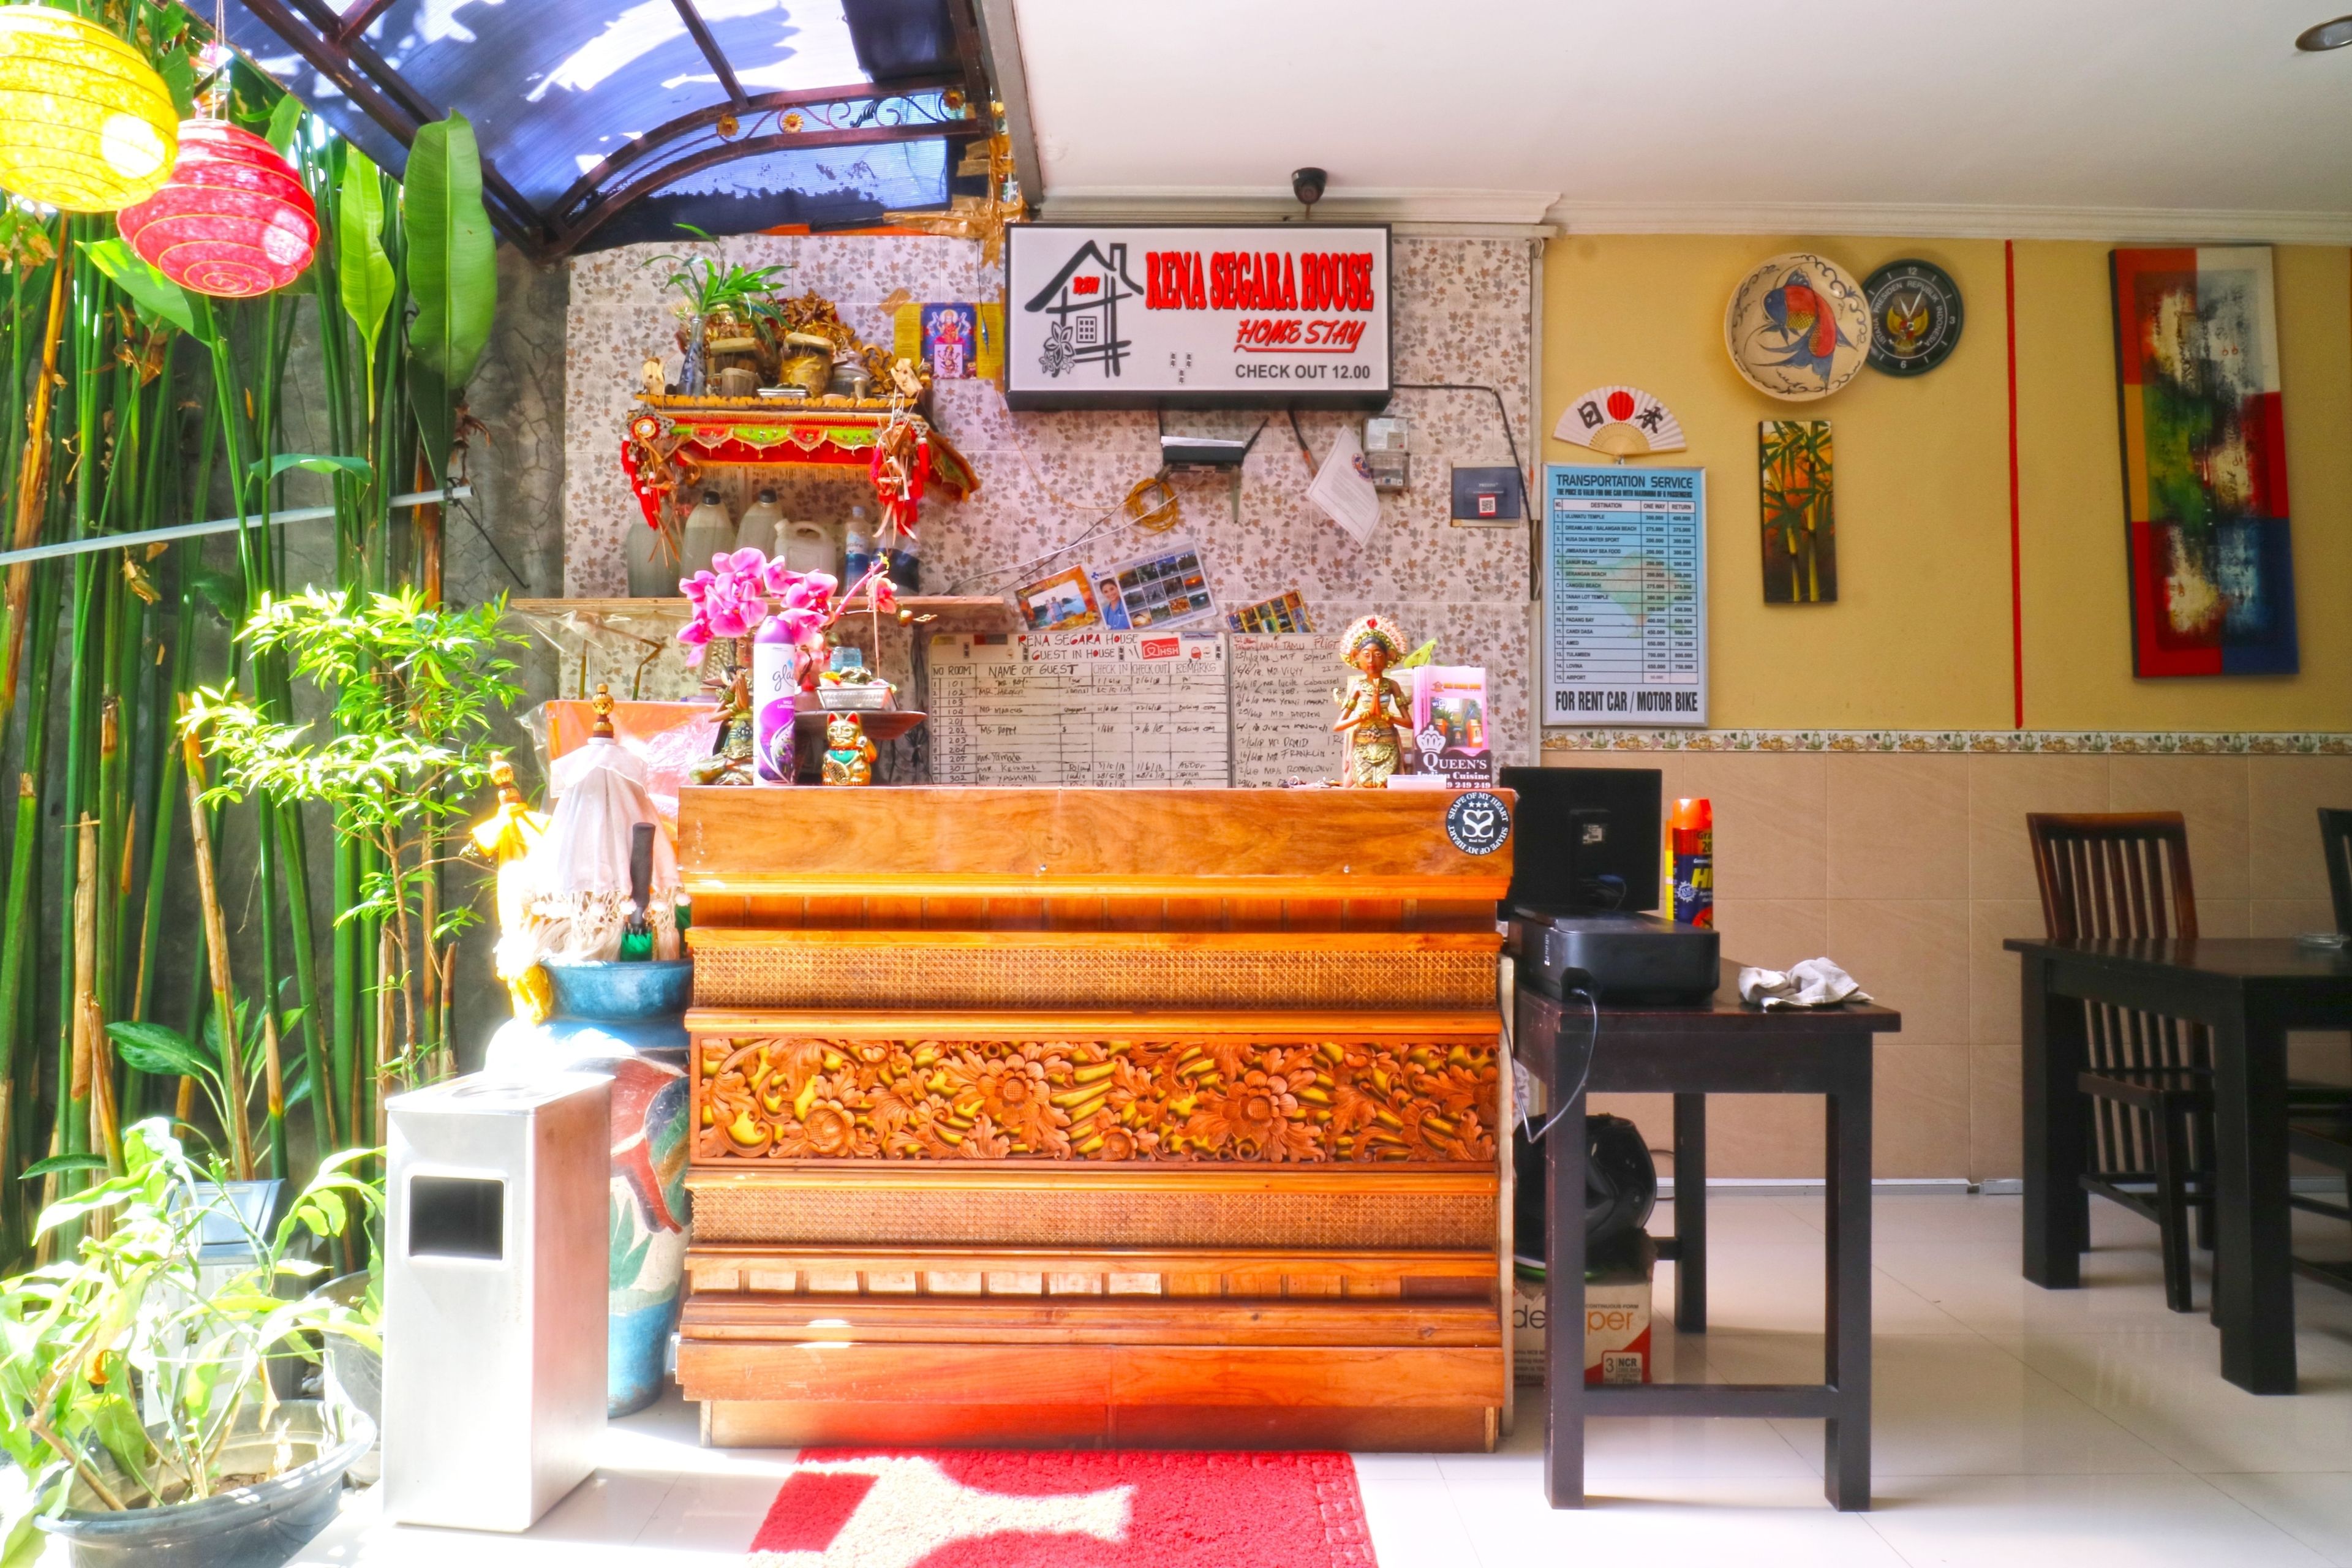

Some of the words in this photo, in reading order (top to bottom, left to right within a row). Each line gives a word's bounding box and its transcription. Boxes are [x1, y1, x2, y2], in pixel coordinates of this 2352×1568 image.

[1072, 276, 1099, 295] RSH
[1146, 252, 1207, 310] RENA
[1210, 252, 1298, 310] SEGARA
[1300, 252, 1374, 311] HOUSE
[1907, 281, 1939, 302] REPUBLIK
[1874, 282, 1902, 313] PRESIDEN
[1236, 320, 1302, 344] HOME
[1307, 320, 1367, 345] STAY
[1873, 318, 1887, 344] ISTANA
[1924, 306, 1943, 346] INDONESIA
[1235, 364, 1290, 379] CHECK
[1295, 365, 1327, 379] OUT
[1333, 366, 1370, 379] 12.00
[1556, 475, 1645, 487] TRANSPORTATION
[1651, 477, 1692, 488] SERVICE
[1018, 635, 1050, 646] RENA
[1055, 634, 1101, 646] SEGARA
[1106, 634, 1139, 644] HOUSE
[1032, 650, 1067, 660] GUEST
[1072, 650, 1082, 659] IN
[1087, 647, 1114, 658] HOUSE
[1159, 647, 1178, 656] HSH
[949, 666, 971, 675] ROOM
[989, 666, 1017, 677] NAME
[1039, 665, 1078, 674] GUEST
[1093, 664, 1115, 674] CHECK
[1133, 664, 1152, 674] CHECK
[1155, 664, 1168, 673] OUT
[1176, 663, 1216, 673] REMARKS
[1556, 691, 1575, 710] FOR
[1578, 691, 1604, 711] RENT
[1607, 692, 1627, 711] CAR
[1630, 692, 1634, 713] /
[1637, 692, 1672, 712] MOTOR
[1676, 692, 1697, 712] BIKE
[1423, 753, 1487, 771] QUEEN'S
[1448, 796, 1466, 820] SHAPE
[1490, 797, 1509, 821] HEART
[1448, 825, 1466, 850] HEART
[1490, 827, 1508, 850] SHAPE
[1605, 1358, 1614, 1373] 3
[1618, 1359, 1637, 1367] NCR
